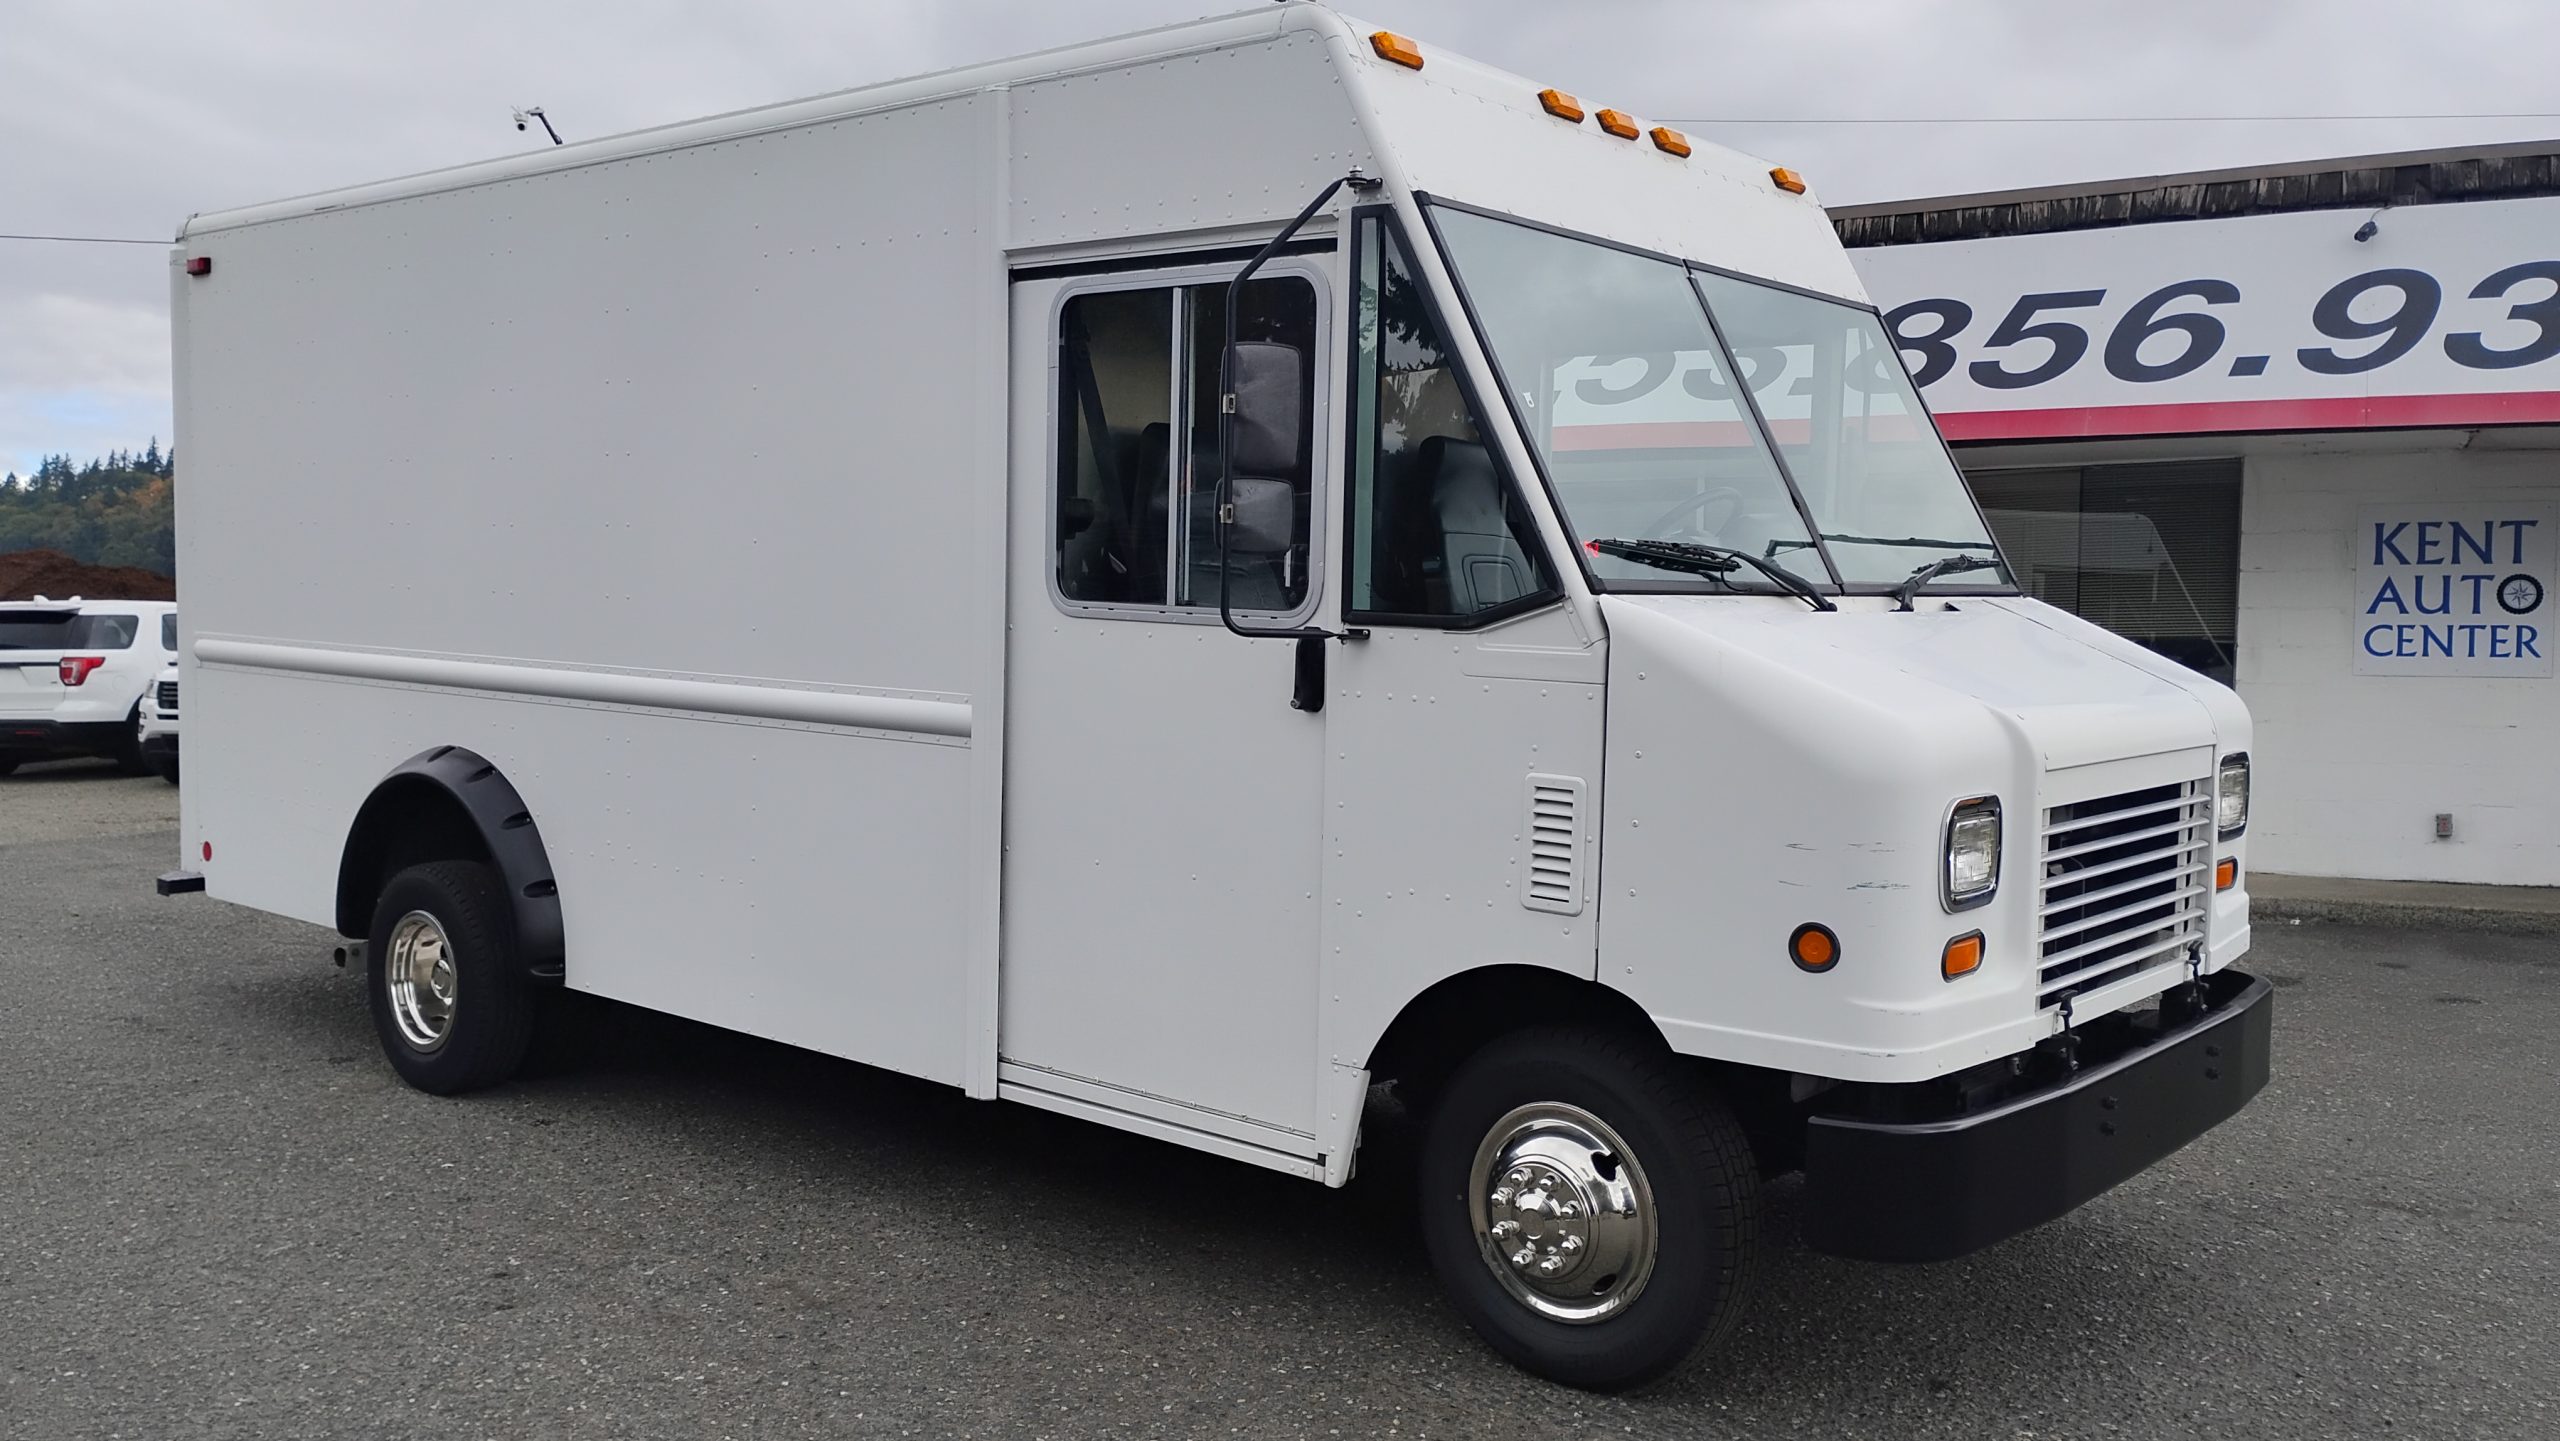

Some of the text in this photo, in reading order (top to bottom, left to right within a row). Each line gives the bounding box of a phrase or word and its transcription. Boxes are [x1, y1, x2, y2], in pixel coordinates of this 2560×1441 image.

[2373, 520, 2539, 566] KENT
[2365, 573, 2544, 615] AUTO
[2363, 624, 2541, 658] CENTER
